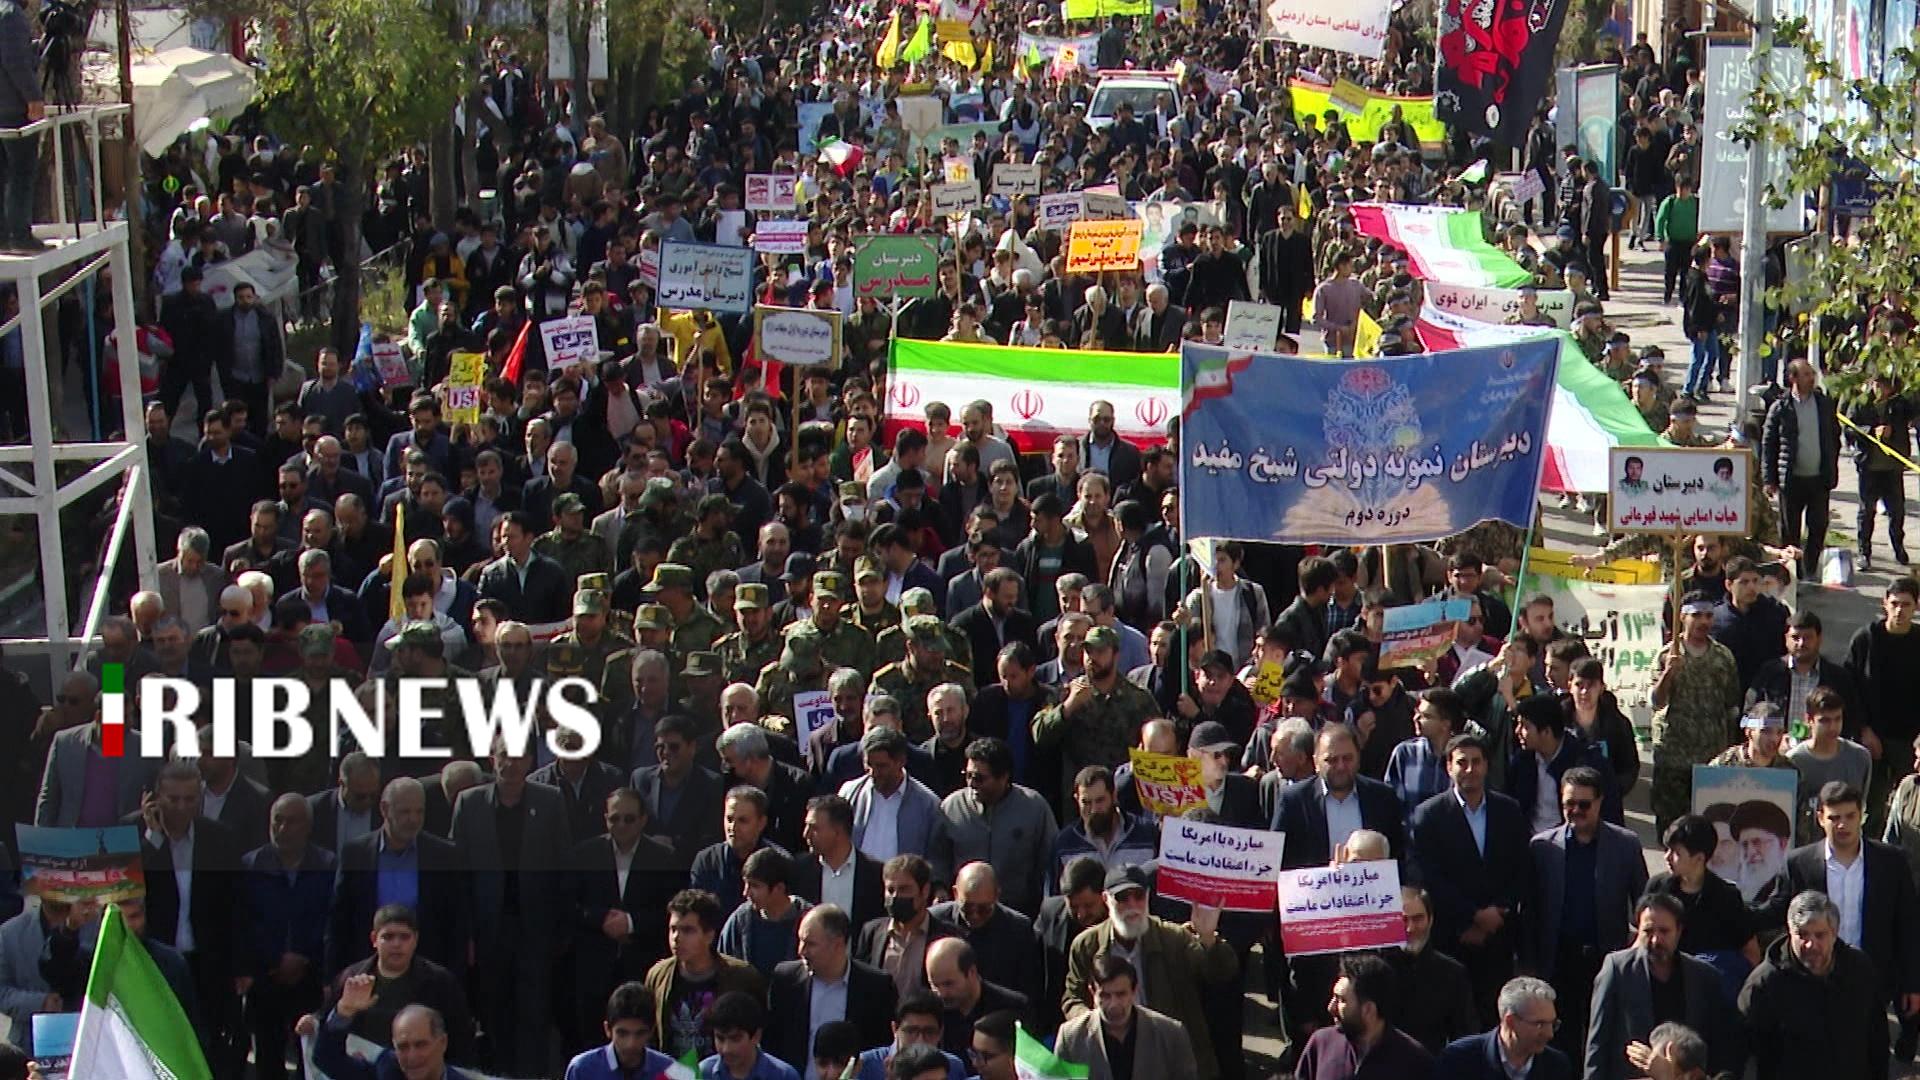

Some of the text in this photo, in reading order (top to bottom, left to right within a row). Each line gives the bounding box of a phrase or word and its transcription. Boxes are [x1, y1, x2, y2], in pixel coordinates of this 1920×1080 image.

[1276, 10, 1305, 25] اردبیل
[1306, 14, 1332, 26] استان
[872, 251, 922, 266] دبیرستان
[859, 272, 931, 293] مدرس
[661, 287, 702, 302] مدرس
[1435, 291, 1457, 307] قوی
[1462, 294, 1488, 310] ایران
[1502, 298, 1519, 313] وی
[1537, 301, 1564, 314] مدرس
[1191, 427, 1532, 489] دبیرستان نمونه دولتی شیخ مفید
[1652, 473, 1705, 496] دبیرستان
[1344, 503, 1412, 528] دوره دوم
[1620, 503, 1657, 526] قهرمانی
[1659, 506, 1681, 525] شهید
[1138, 779, 1206, 808] USA
[1217, 832, 1226, 847] با
[1227, 835, 1264, 852] مبارزه
[1164, 848, 1273, 876] جزء اعتقادات ماست
[1333, 870, 1342, 884] با
[1343, 868, 1380, 887] مبارزه
[1286, 892, 1395, 914] جزء اعتقادات ماست
